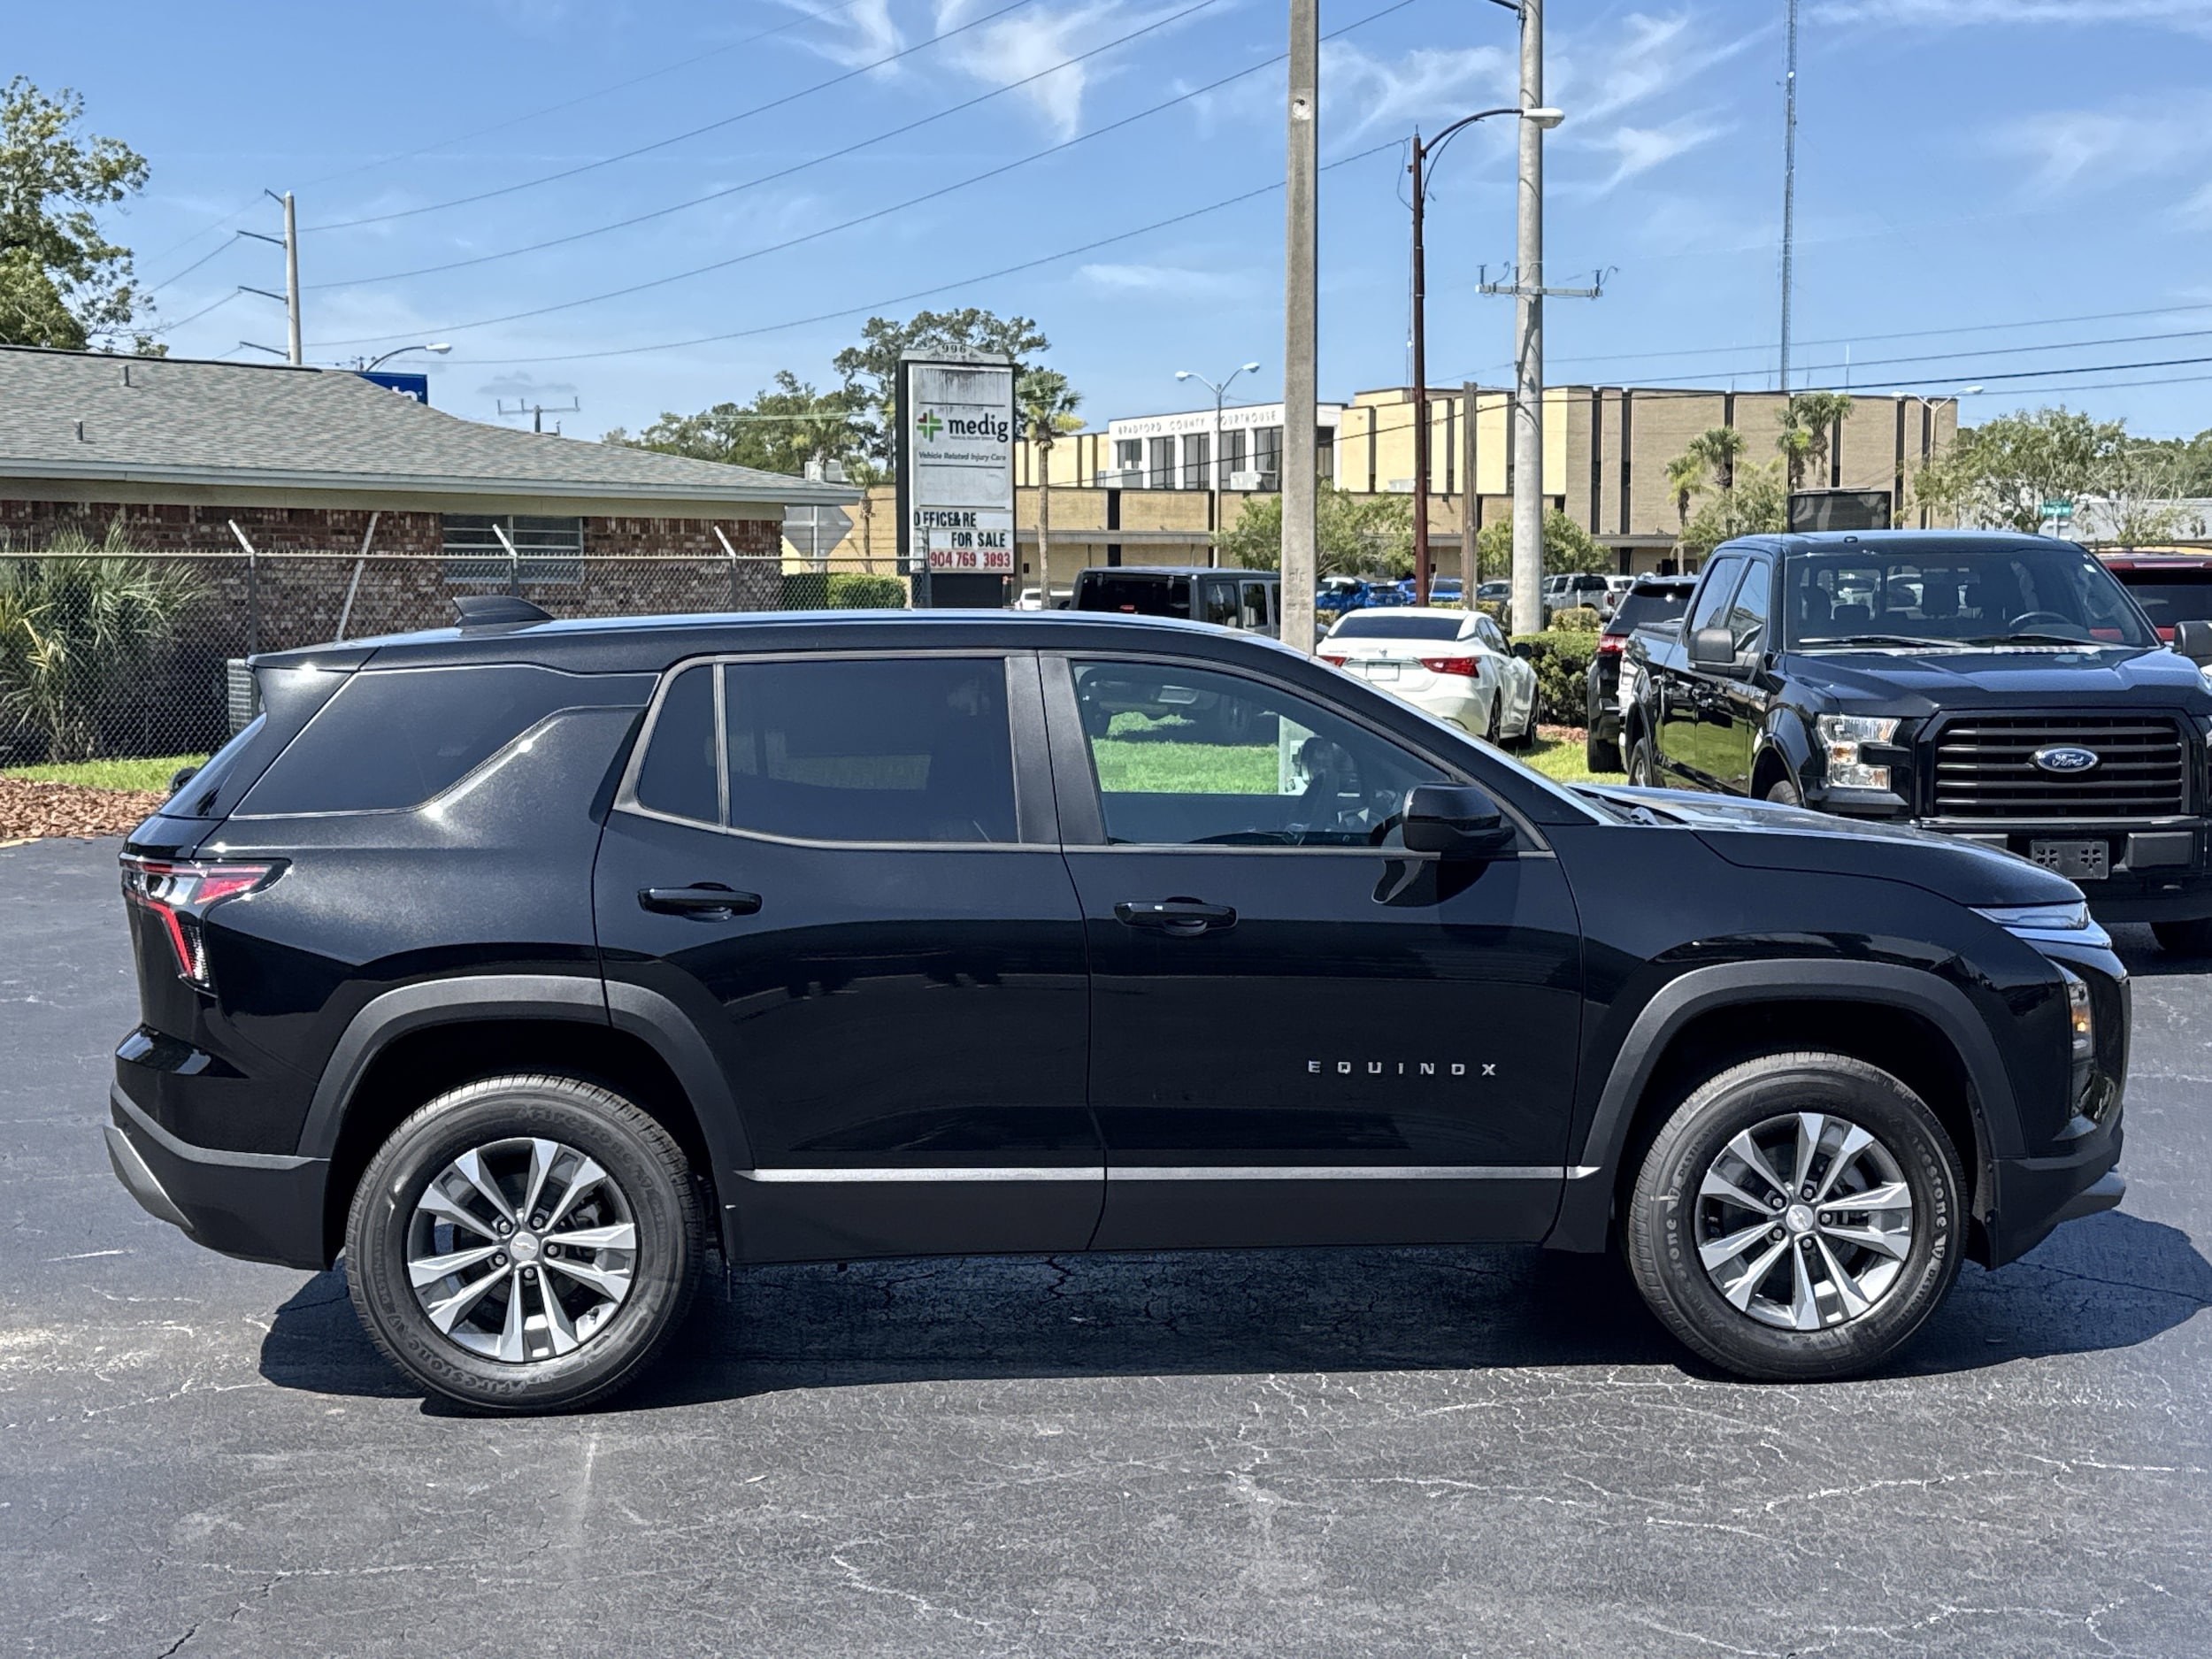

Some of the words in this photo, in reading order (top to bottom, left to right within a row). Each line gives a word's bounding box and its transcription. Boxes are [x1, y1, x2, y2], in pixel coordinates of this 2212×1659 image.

[941, 343, 966, 354] 996
[948, 412, 1009, 442] medig
[1118, 421, 1162, 435] BRADFORD
[1169, 417, 1205, 432] COUNTY
[971, 453, 989, 462] Injury
[963, 511, 977, 527] RE
[951, 532, 972, 548] FOR
[978, 532, 1006, 548] SALE
[930, 551, 953, 567] 904
[956, 551, 977, 567] 769
[983, 551, 1010, 567] 3893
[2052, 754, 2084, 767] Ford
[1308, 1060, 1496, 1076] EQUINOX
[404, 1337, 514, 1396] Firestone
